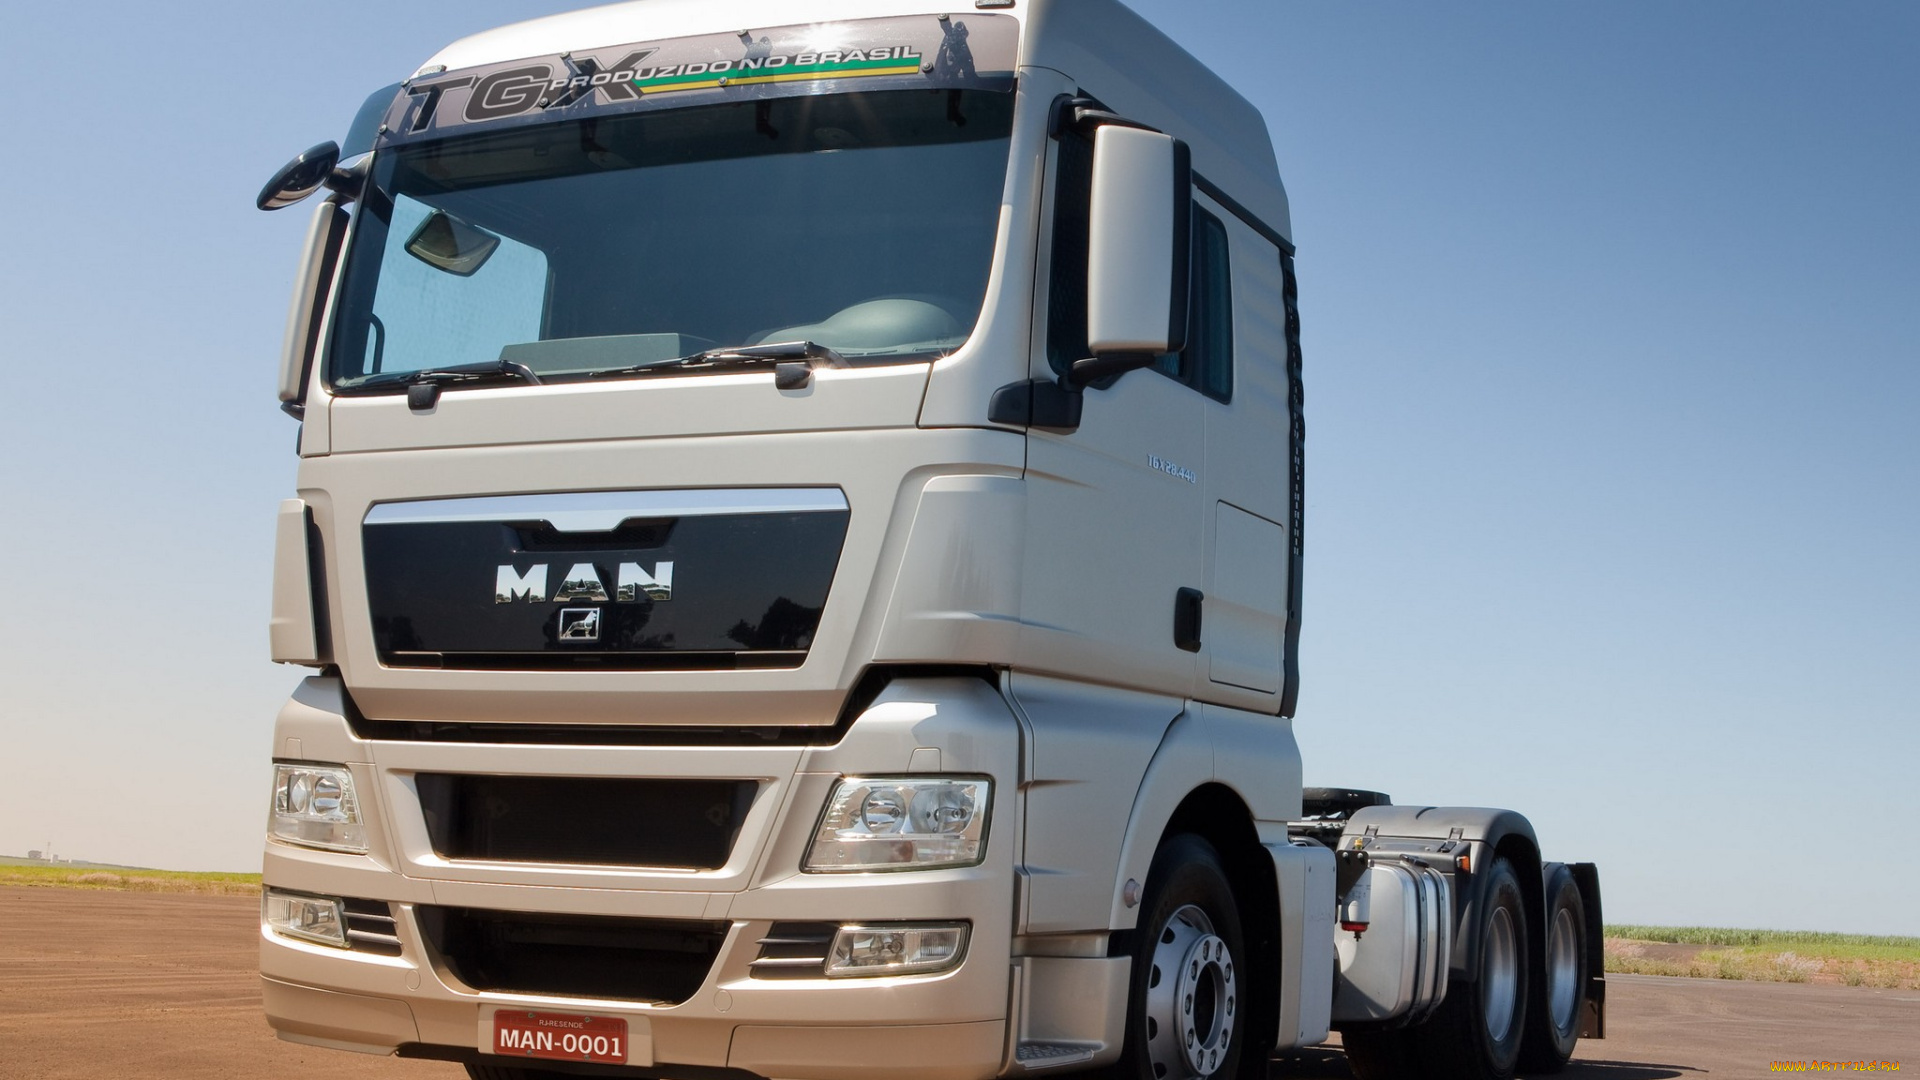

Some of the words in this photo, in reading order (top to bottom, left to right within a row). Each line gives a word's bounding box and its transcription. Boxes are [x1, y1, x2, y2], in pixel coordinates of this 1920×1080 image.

[549, 60, 732, 92] PRODUZIDO
[738, 55, 788, 71] NO
[794, 46, 922, 66] BRASIL
[404, 47, 660, 136] TGX
[495, 561, 674, 604] MAN
[500, 1028, 622, 1057] MAN-0001
